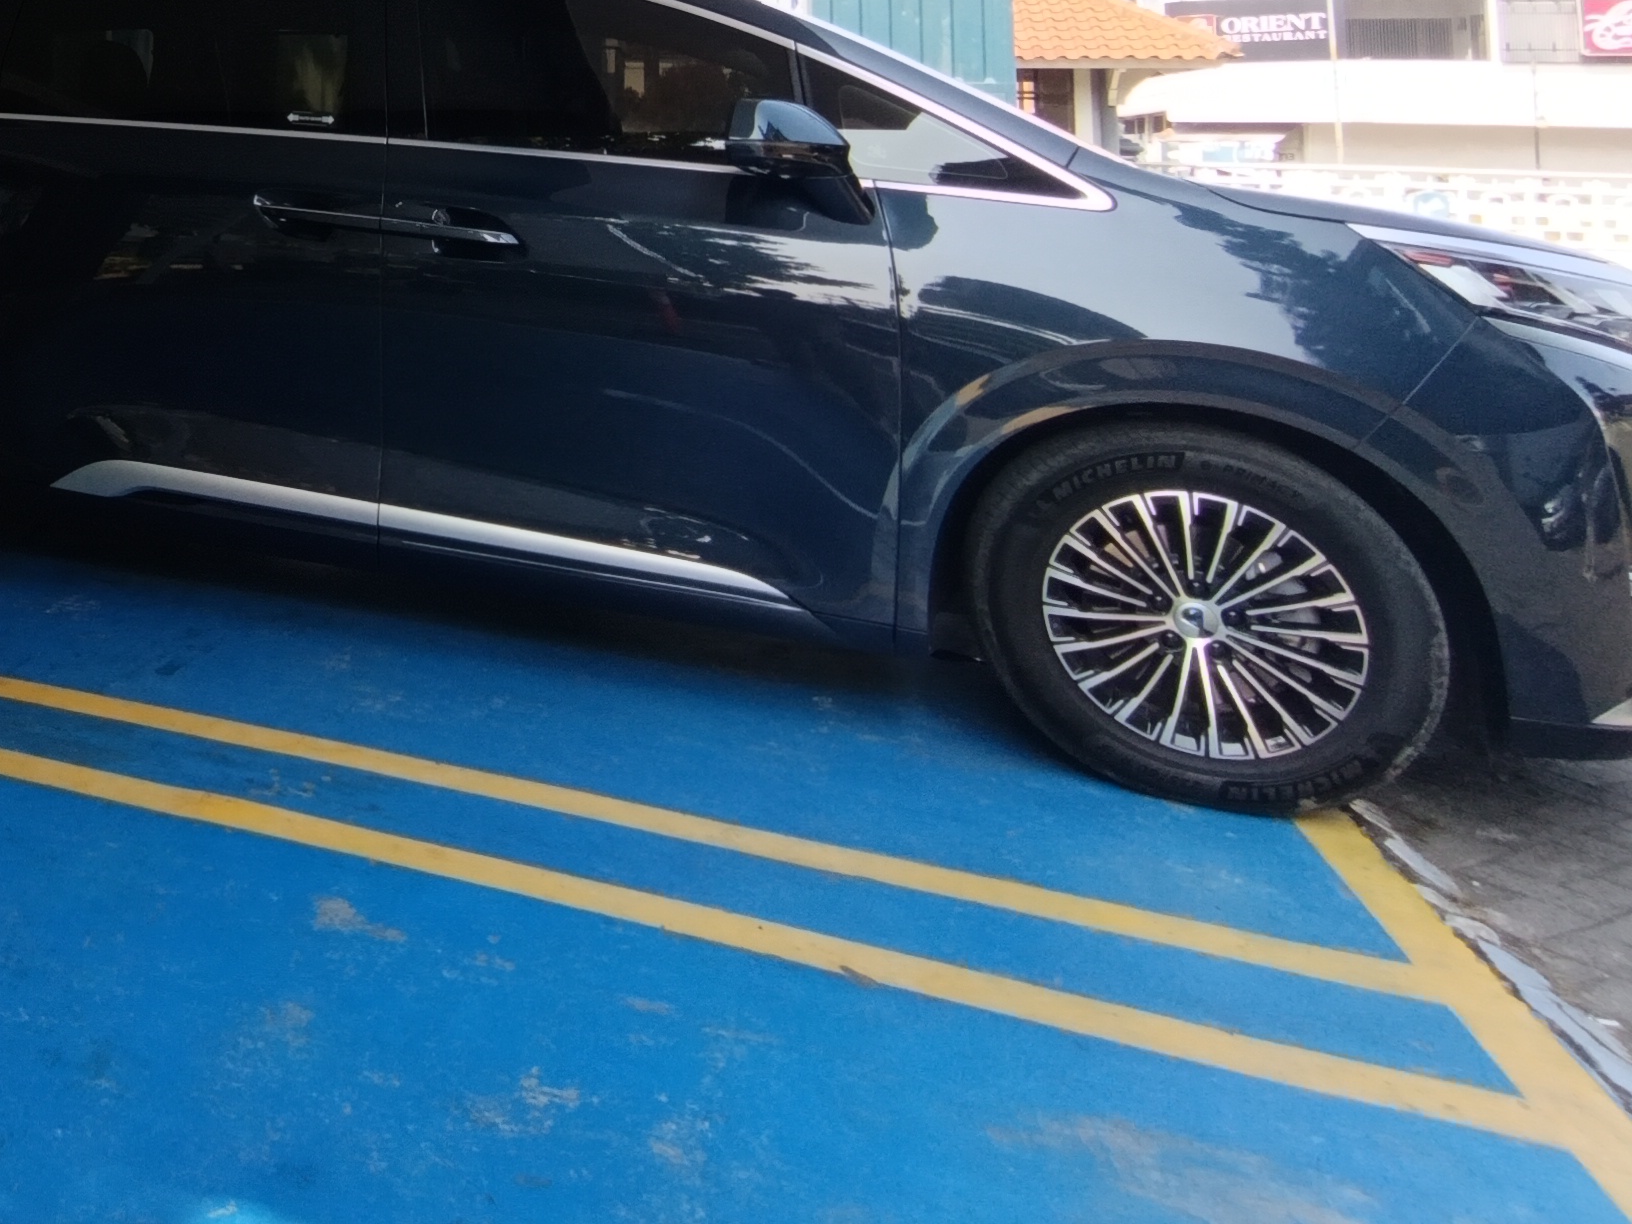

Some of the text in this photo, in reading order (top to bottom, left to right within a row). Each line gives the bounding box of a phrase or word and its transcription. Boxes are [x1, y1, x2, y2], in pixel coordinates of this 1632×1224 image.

[1221, 13, 1326, 34] ORIENT
[1052, 454, 1177, 500] MICHELIN
[1227, 760, 1362, 800] MICHELIN
